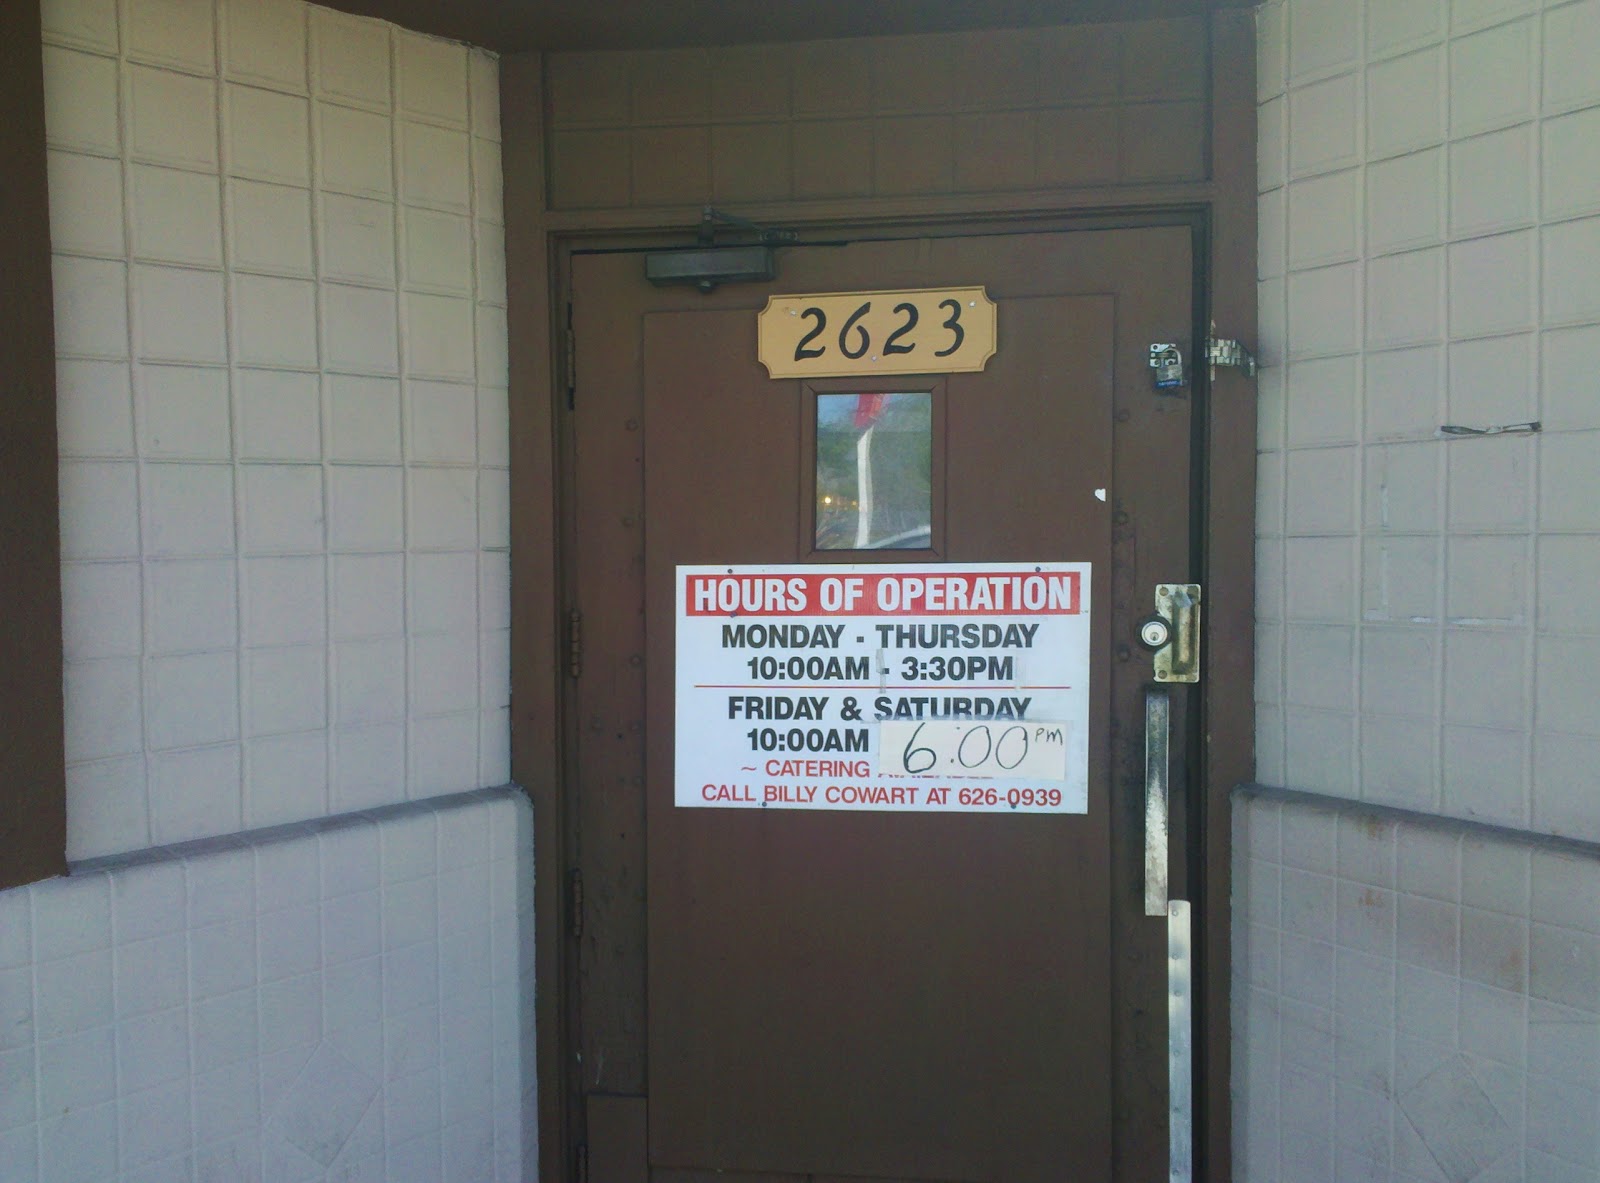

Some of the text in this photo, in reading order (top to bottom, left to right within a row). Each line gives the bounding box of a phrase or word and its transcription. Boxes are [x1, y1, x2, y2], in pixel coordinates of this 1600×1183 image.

[794, 298, 965, 361] 2623
[694, 575, 1072, 611] HOURS OF OPERATION
[721, 624, 846, 648] MONDAY
[875, 623, 1040, 649] THURSDAY
[747, 656, 870, 680] 10:00AM
[901, 657, 1014, 681] 3:30PM
[728, 696, 1032, 721] FRIDAY & SATURDAY
[747, 728, 869, 752] 10:00AM
[765, 759, 870, 778] CATERING
[701, 784, 1062, 806] CALL BILLY COWART AT 626-0939
